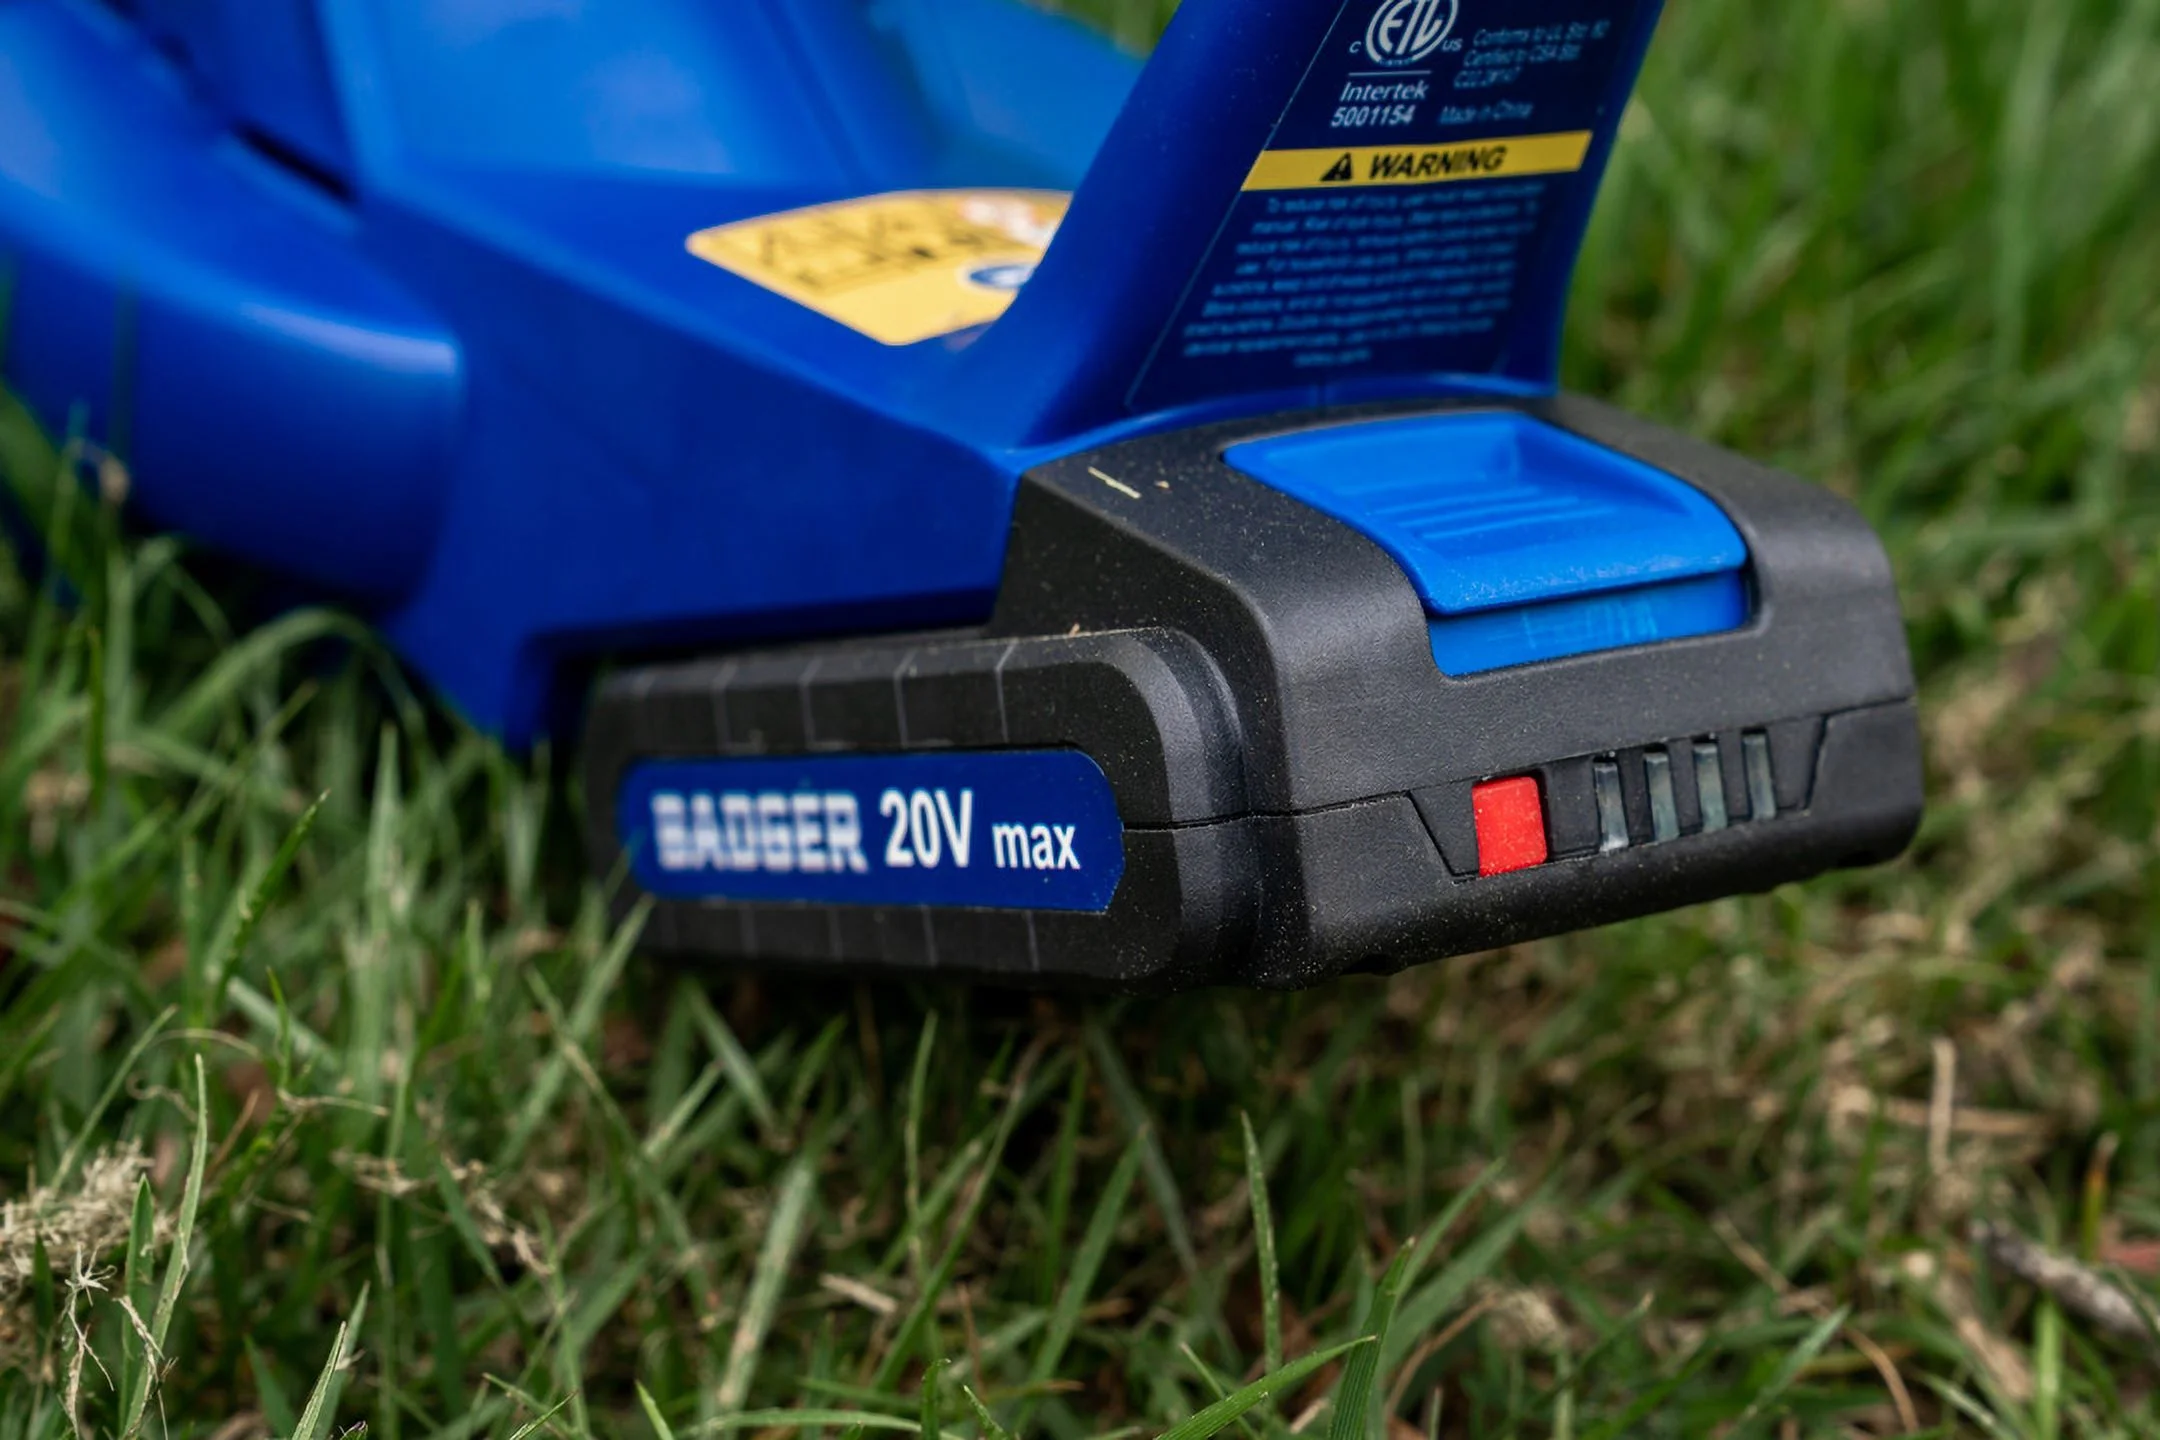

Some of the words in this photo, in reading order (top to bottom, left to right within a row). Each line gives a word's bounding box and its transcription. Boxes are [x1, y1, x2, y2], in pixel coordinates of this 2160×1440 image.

[1441, 38, 1463, 53] US
[1339, 79, 1430, 103] Intertek
[1330, 104, 1416, 128] 5001154
[1368, 145, 1508, 180] WARNING
[652, 789, 869, 875] BADGER
[880, 788, 974, 868] 20V
[991, 821, 1081, 870] max
